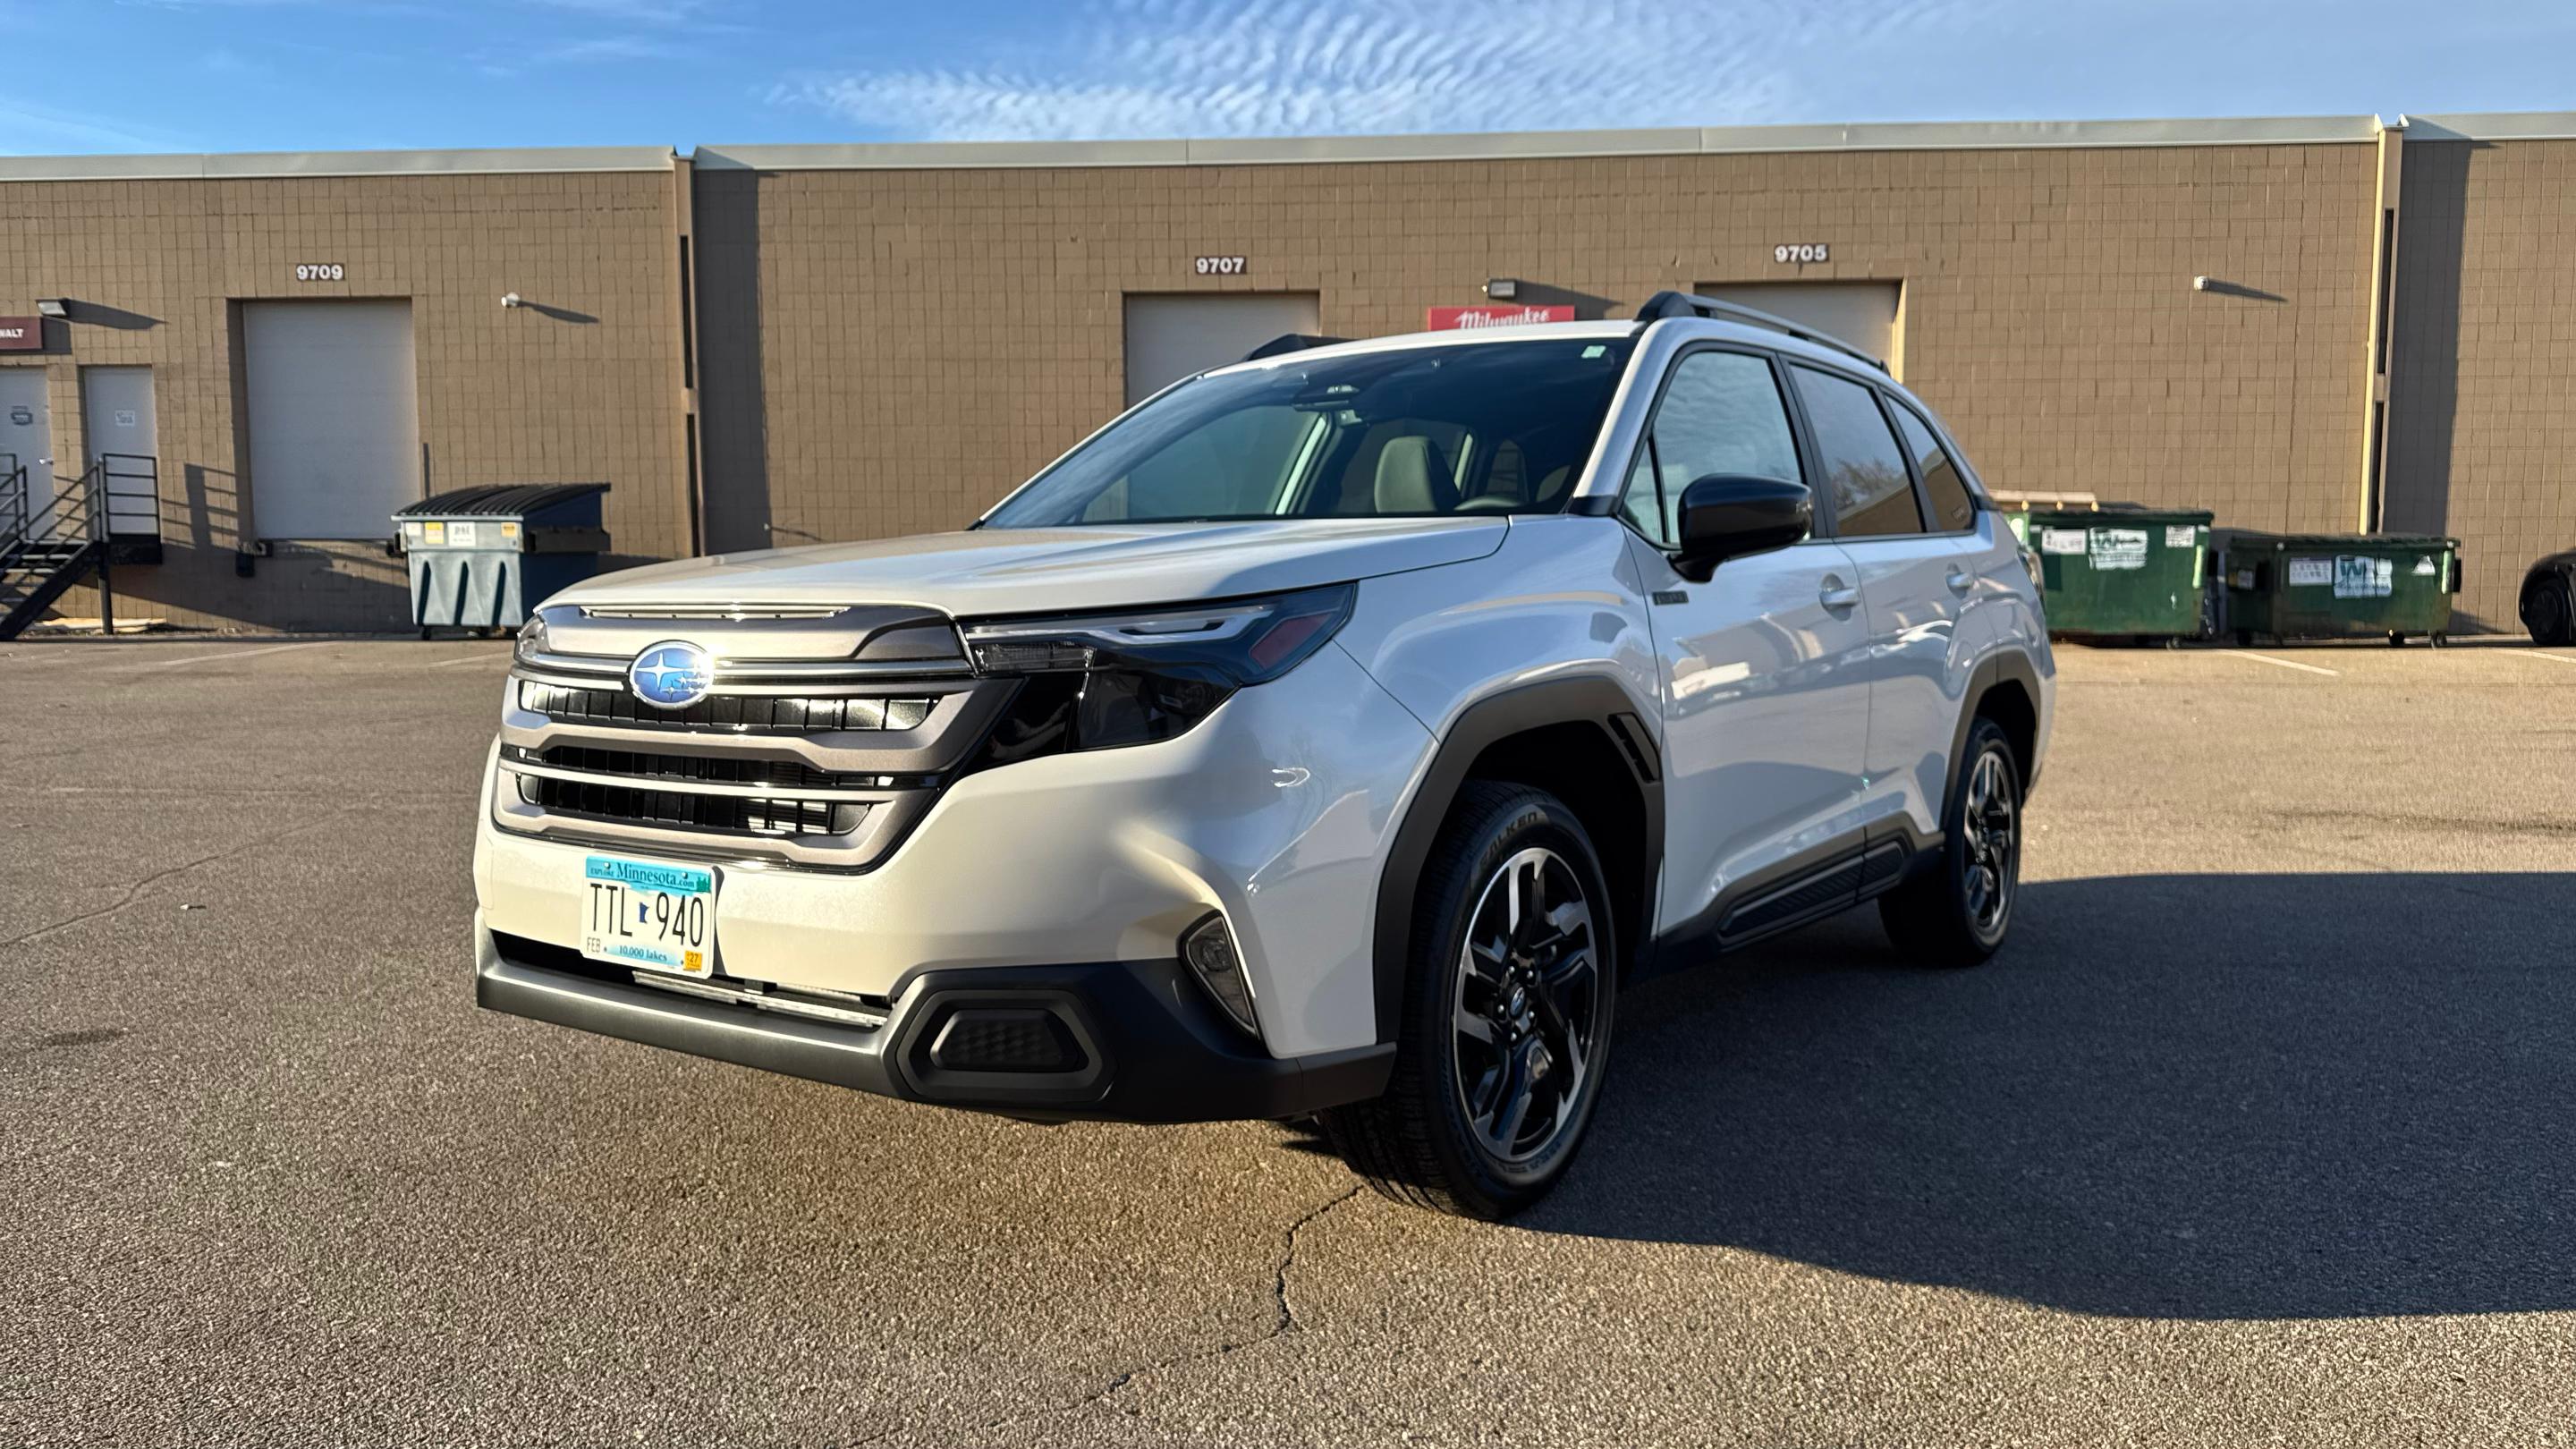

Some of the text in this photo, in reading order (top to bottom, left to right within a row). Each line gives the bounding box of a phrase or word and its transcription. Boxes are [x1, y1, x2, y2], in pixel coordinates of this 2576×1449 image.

[1775, 243, 1827, 263] 9705
[296, 264, 343, 280] 9709
[1196, 257, 1244, 274] 9707
[1454, 306, 1550, 329] Milwaukee
[589, 883, 705, 948] TTL 940
[587, 936, 601, 953] FEB
[646, 947, 668, 962] lakes
